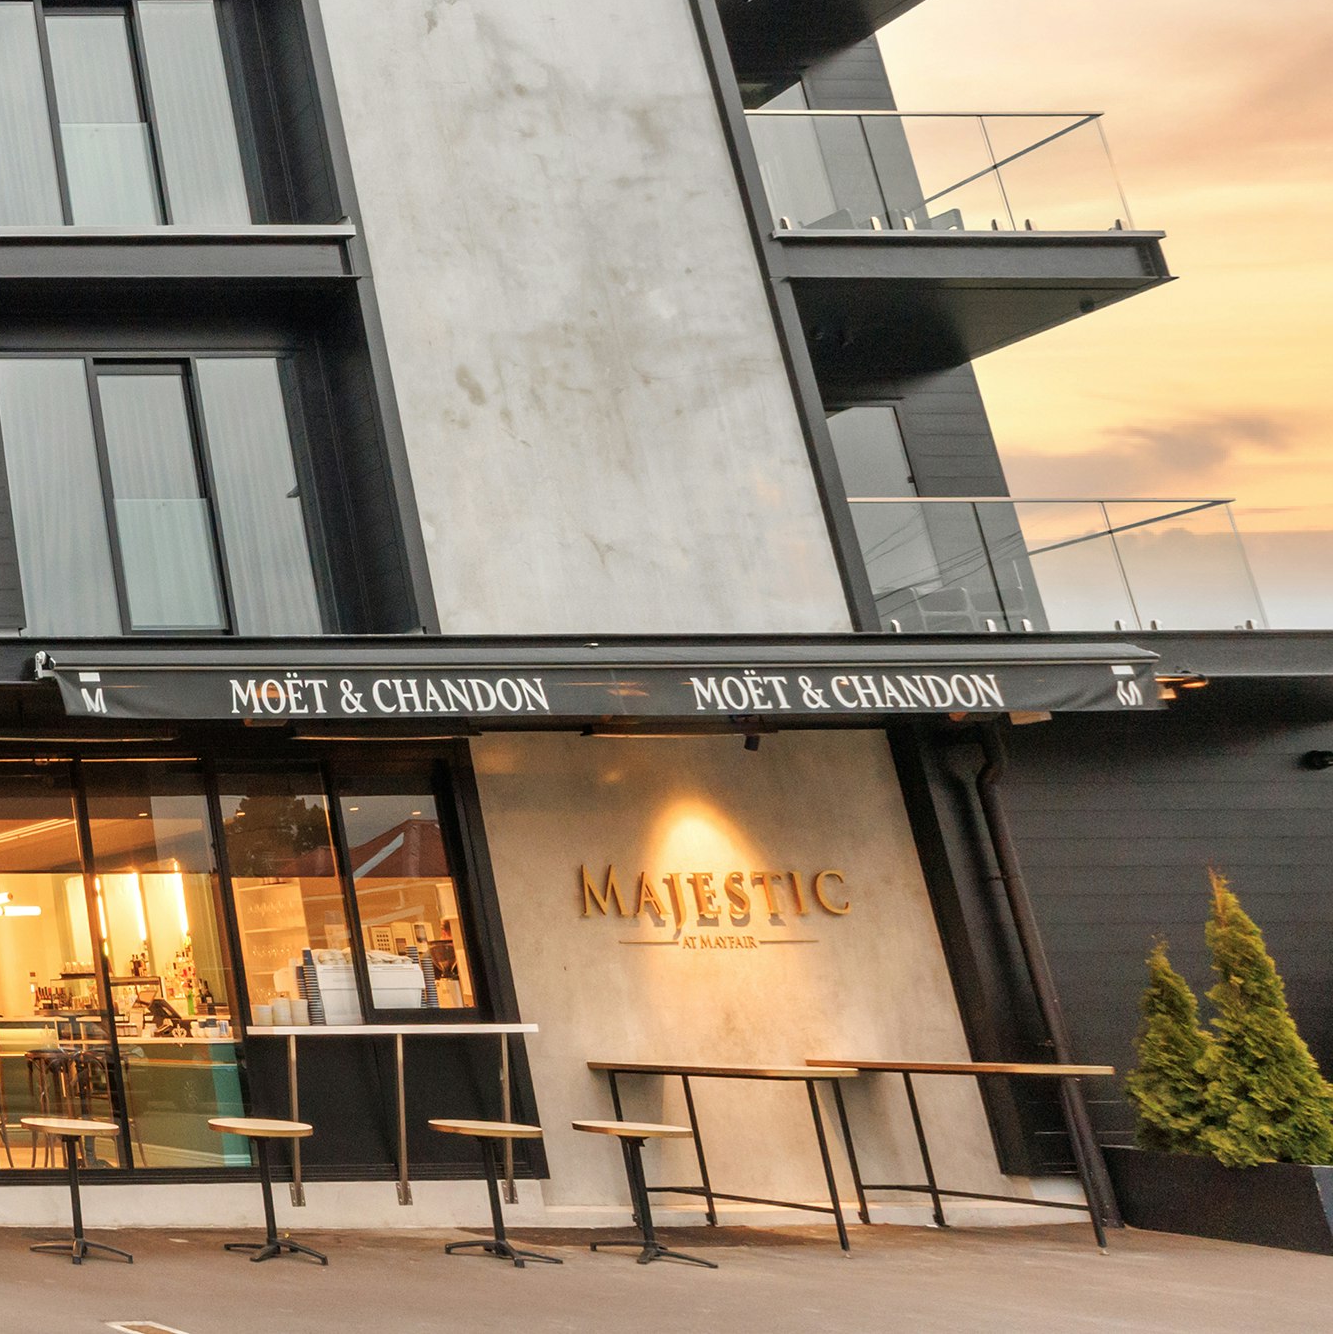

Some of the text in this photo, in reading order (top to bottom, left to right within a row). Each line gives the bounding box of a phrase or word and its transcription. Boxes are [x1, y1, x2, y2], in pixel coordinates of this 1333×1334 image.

[229, 672, 551, 714] MOËT & CHANDON
[689, 669, 1005, 711] MOËT & CHANDON
[580, 863, 852, 930] MAJESTIC
[683, 934, 758, 949] AT MAYFAIR
